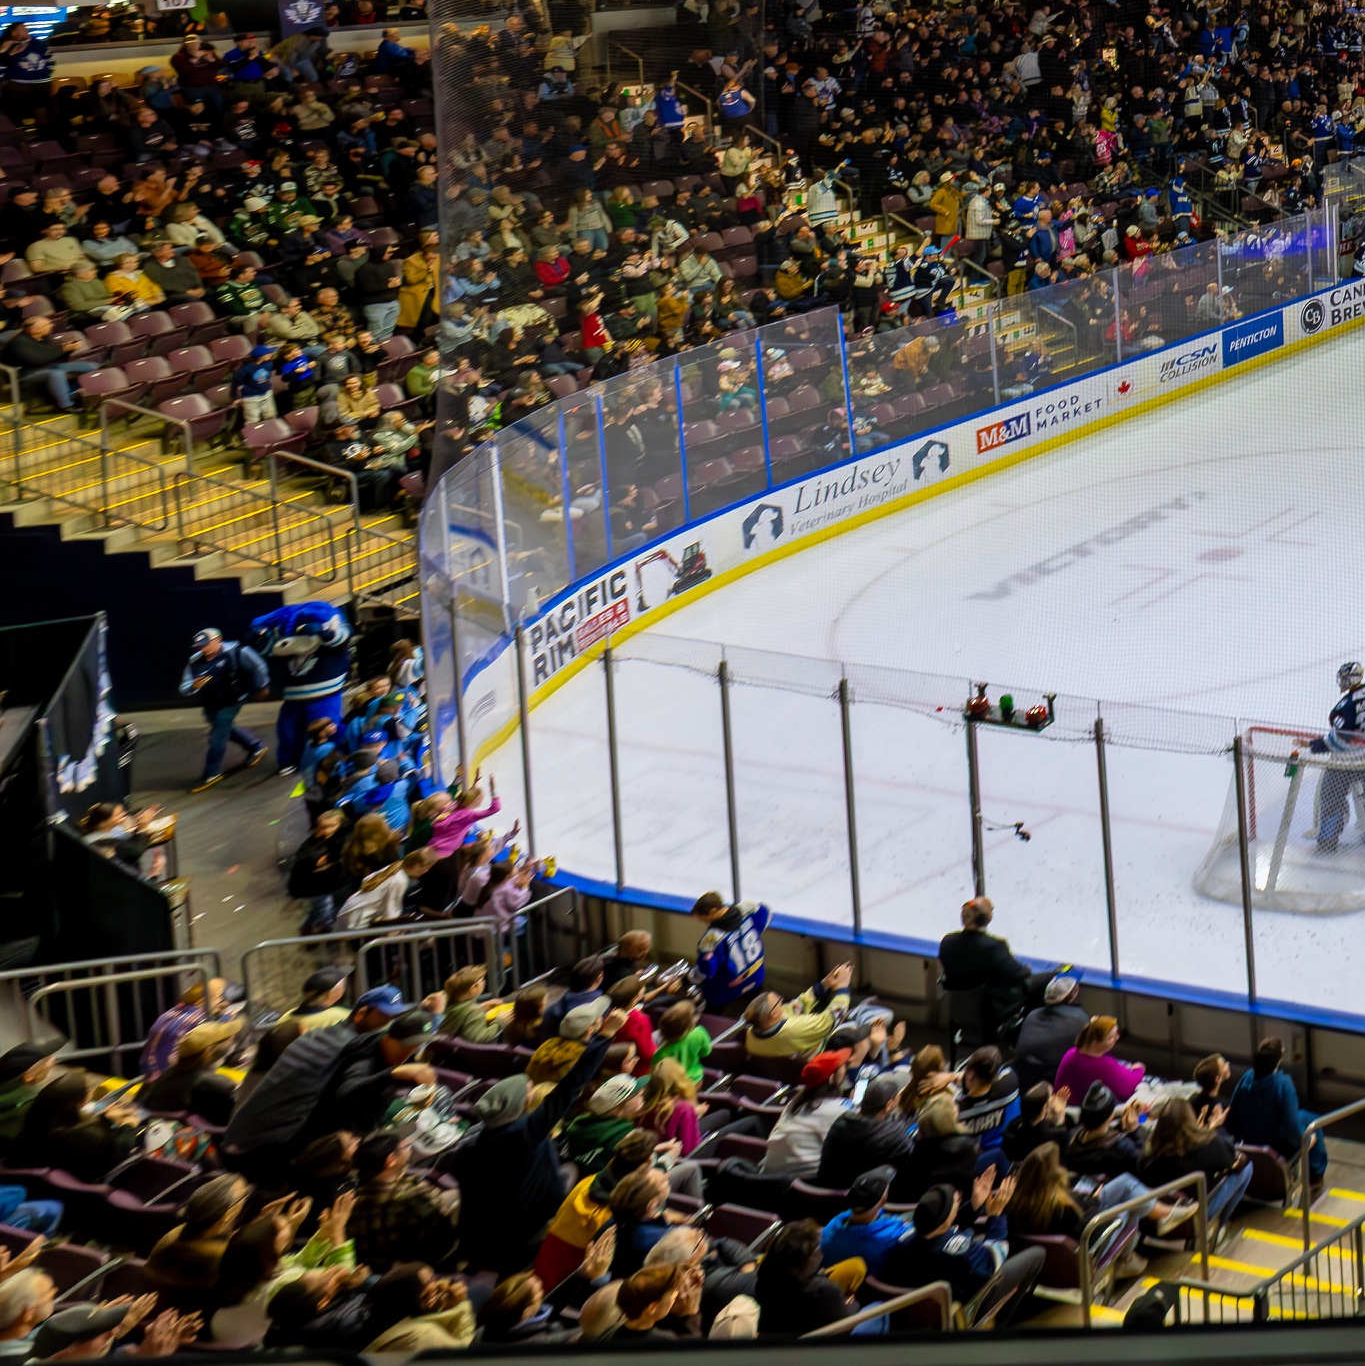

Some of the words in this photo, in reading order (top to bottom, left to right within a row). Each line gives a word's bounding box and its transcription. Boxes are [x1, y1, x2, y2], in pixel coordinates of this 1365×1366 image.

[1176, 343, 1218, 365] CSN
[1229, 325, 1278, 352] PENTICTON
[1160, 354, 1218, 383] COLLISION
[1036, 395, 1079, 418] FOOD
[1037, 398, 1102, 431] MARKET
[979, 414, 1029, 450] M&M
[793, 458, 900, 515] Lindsey
[790, 504, 855, 535] Veterinary
[858, 479, 908, 509] Hospital
[530, 570, 627, 656] PACIFIC
[534, 633, 575, 687] RIM
[730, 928, 763, 974] 18
